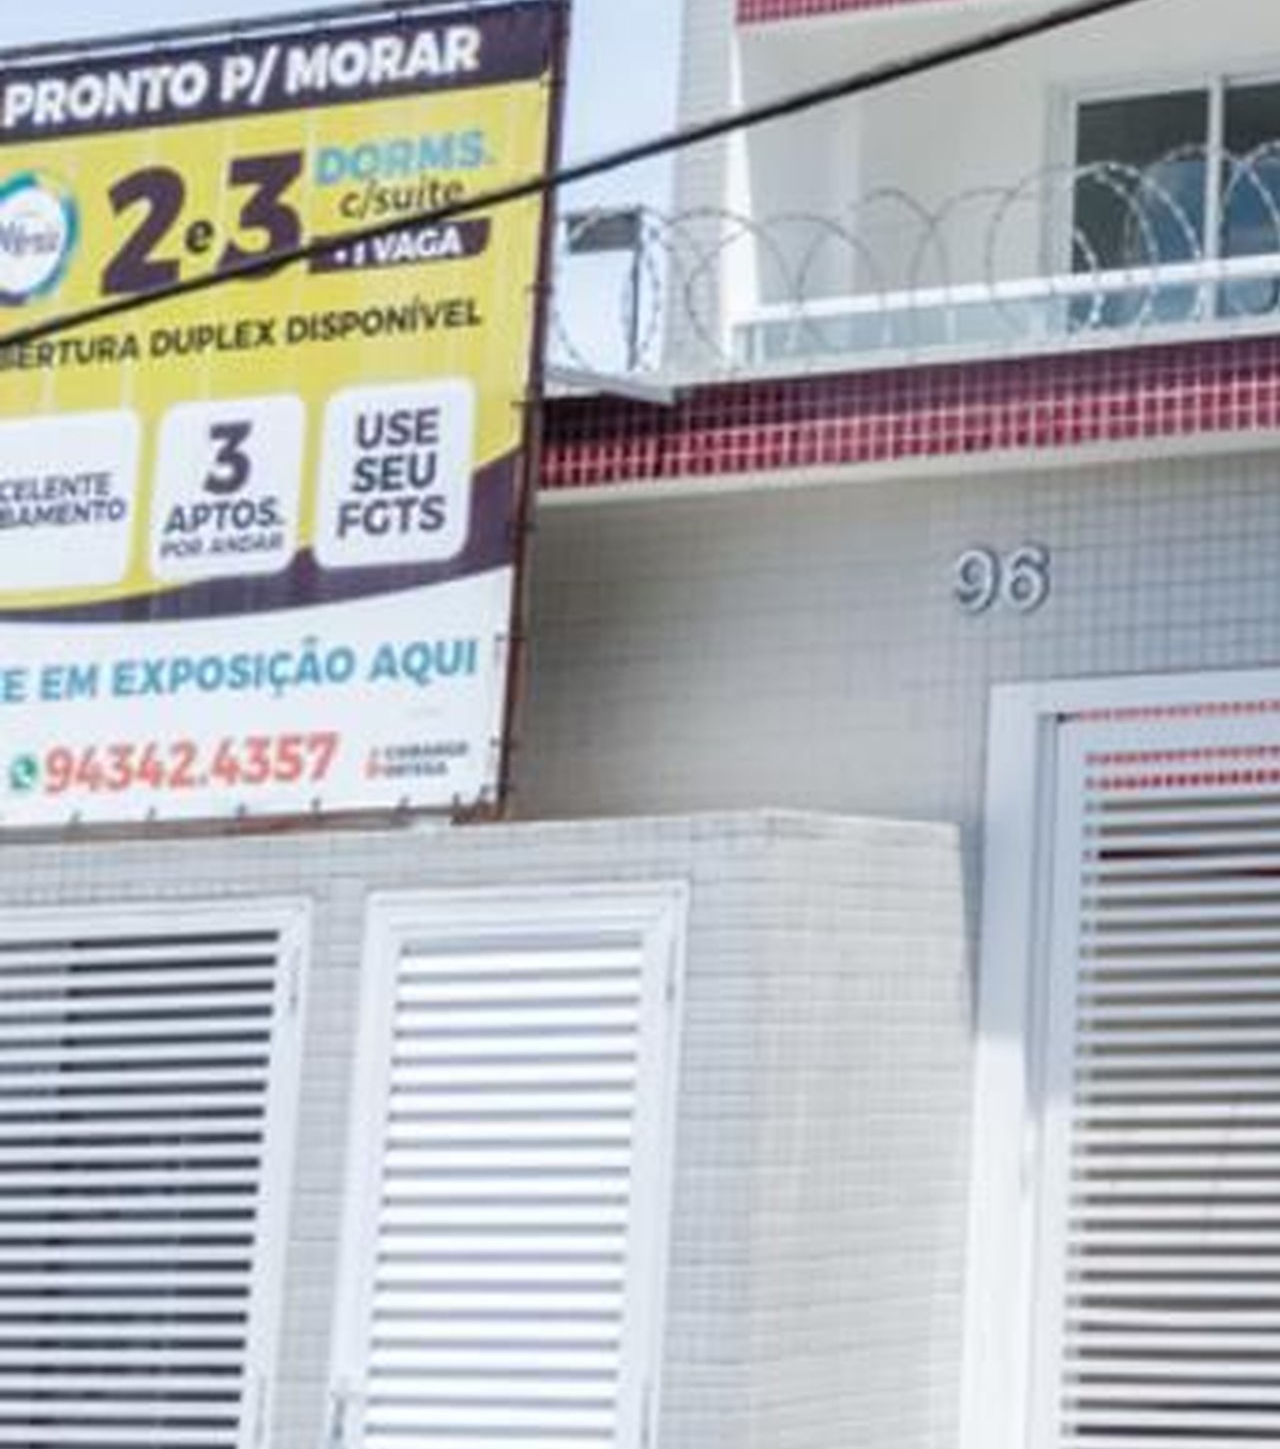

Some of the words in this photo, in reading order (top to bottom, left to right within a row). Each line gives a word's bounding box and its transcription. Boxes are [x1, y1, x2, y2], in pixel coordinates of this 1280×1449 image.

[3, 61, 209, 129] PRONTO
[219, 45, 280, 105] P/
[284, 25, 481, 93] MORAR
[100, 165, 186, 297] 2
[184, 219, 215, 255] e
[216, 148, 306, 281] 3
[373, 225, 464, 261] VAGA
[149, 319, 275, 358] DUPLEX
[285, 295, 482, 345] DISPONÍVEL
[203, 419, 254, 496] 3
[357, 407, 440, 450] USE
[351, 451, 437, 493] SEU
[336, 494, 448, 539] FGTS
[952, 541, 1052, 615] 96
[39, 660, 99, 701] EM
[111, 635, 357, 698] EXPOSIÇÃO
[366, 638, 479, 686] AQUI
